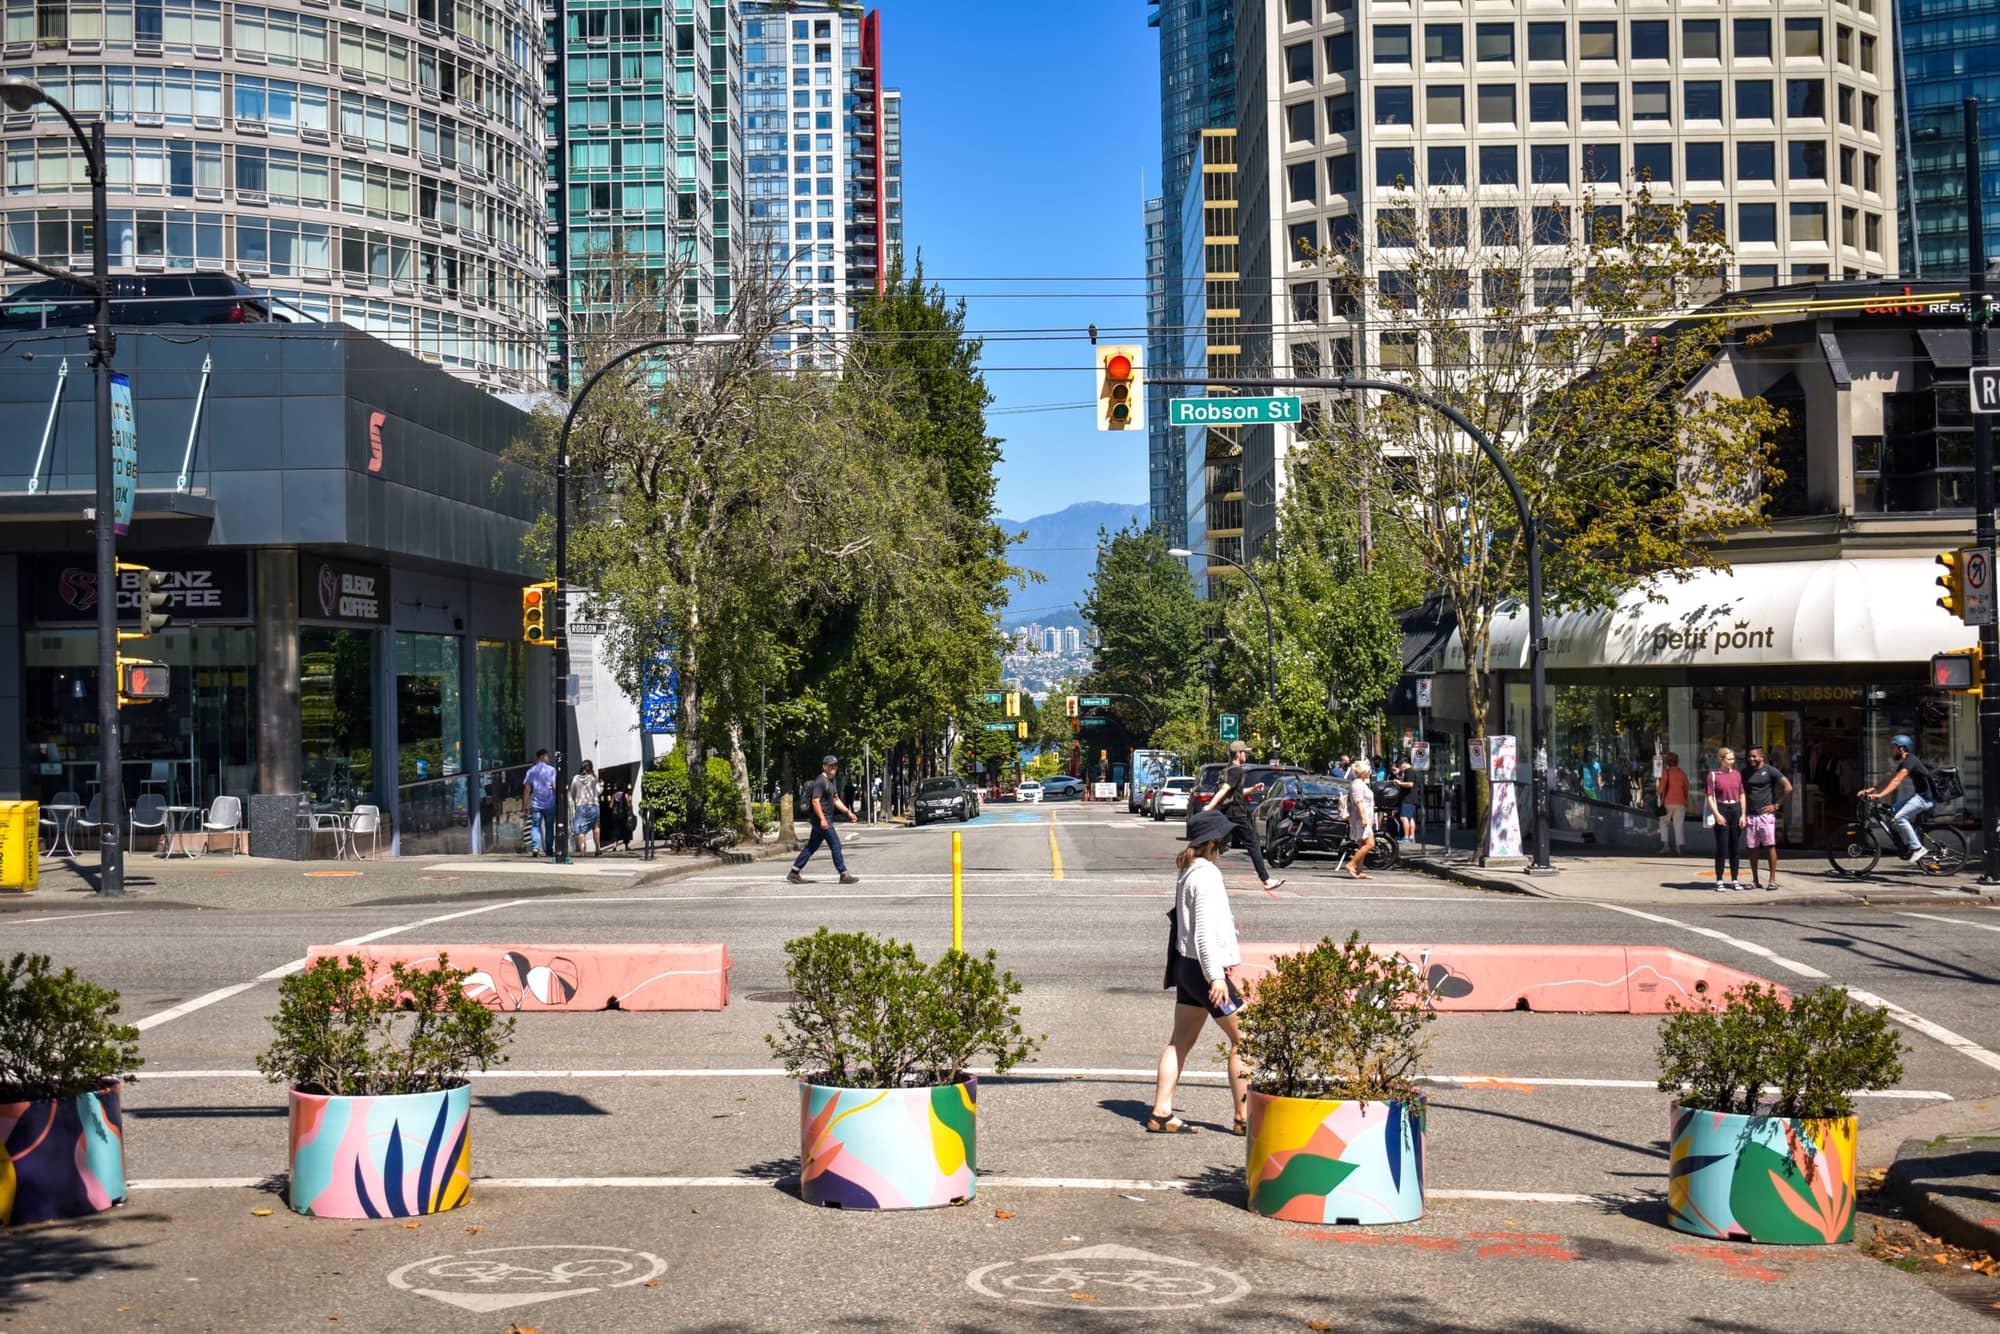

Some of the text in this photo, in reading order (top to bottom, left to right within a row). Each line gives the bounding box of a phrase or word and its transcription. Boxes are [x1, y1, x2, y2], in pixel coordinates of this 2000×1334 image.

[1982, 376, 2000, 405] R
[1180, 401, 1291, 421] Robson St
[121, 570, 213, 589] BNZ
[341, 573, 376, 597] BLENZ
[116, 589, 222, 608] COFEE
[340, 596, 379, 618] COFFEE
[571, 624, 597, 633] ROBSON
[1652, 627, 1708, 656] petit
